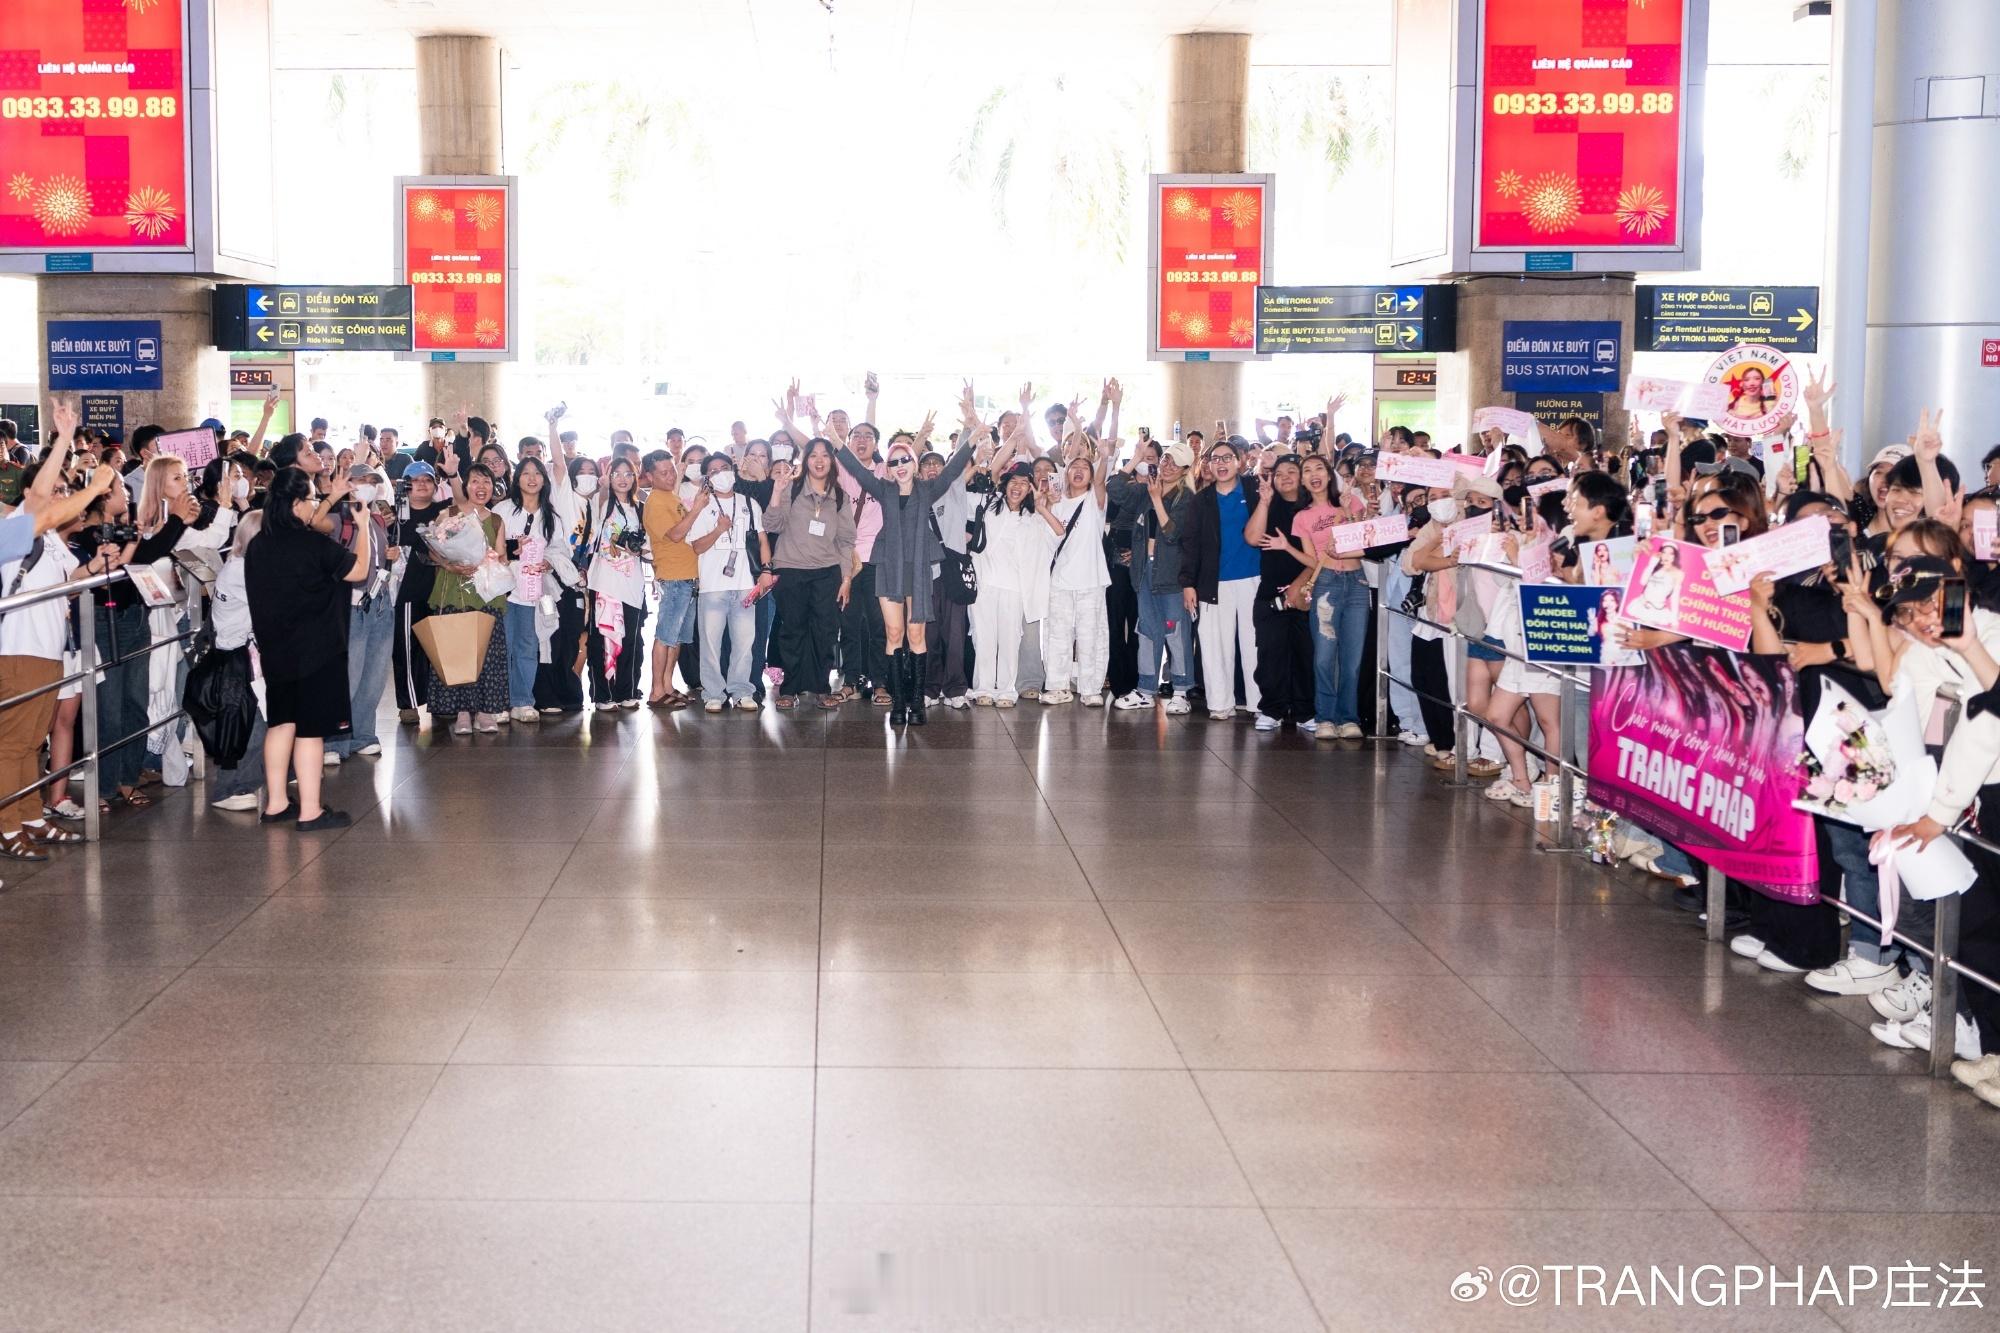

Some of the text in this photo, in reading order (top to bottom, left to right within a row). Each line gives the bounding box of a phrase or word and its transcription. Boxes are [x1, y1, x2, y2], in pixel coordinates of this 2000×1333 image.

[38, 61, 135, 75] LIÊN HỆ QUẢNG CÁO
[1532, 57, 1633, 70] LIÊN HỆ QUẢNG CÁO
[2, 96, 176, 118] 0933.33.99.88
[1493, 93, 1674, 115] 0933.33.99.88
[412, 272, 502, 284] 0933.33.99.88
[1166, 271, 1257, 283] 0933.33.99.88
[306, 291, 379, 304] ĐIỂM ĐÓN TAXI
[1264, 297, 1275, 305] GA
[1285, 297, 1312, 305] TRONG
[1661, 290, 1730, 303] XE HỢP ĐỒNG
[306, 323, 407, 336] ĐÓN XE CÔNG NGHỆ
[1359, 326, 1373, 334] TÀU
[1660, 325, 1673, 333] Car
[1703, 326, 1742, 334] Limousine
[1743, 326, 1771, 334] Service
[51, 337, 131, 352] ĐIỂM ĐÓN XE BUÝT
[322, 337, 345, 345] Hailing
[1506, 337, 1590, 353] ĐIỂM ĐÓN XE BUÝT
[51, 364, 132, 375] BUS STATION
[1506, 364, 1589, 375] BUS STATION
[235, 372, 271, 383] 12:47
[1536, 399, 1583, 408] HƯỚNG RA
[1583, 410, 1599, 419] PHÍ
[1538, 595, 1570, 605] EM LÀ
[1526, 619, 1549, 628] ĐÓN
[1569, 622, 1587, 630] HAI
[1555, 632, 1589, 642] TRANG
[1544, 644, 1567, 653] HỌC
[1568, 645, 1592, 654] SINH
[1617, 735, 1697, 811] TRANG
[1696, 775, 1756, 843] PHÁP
